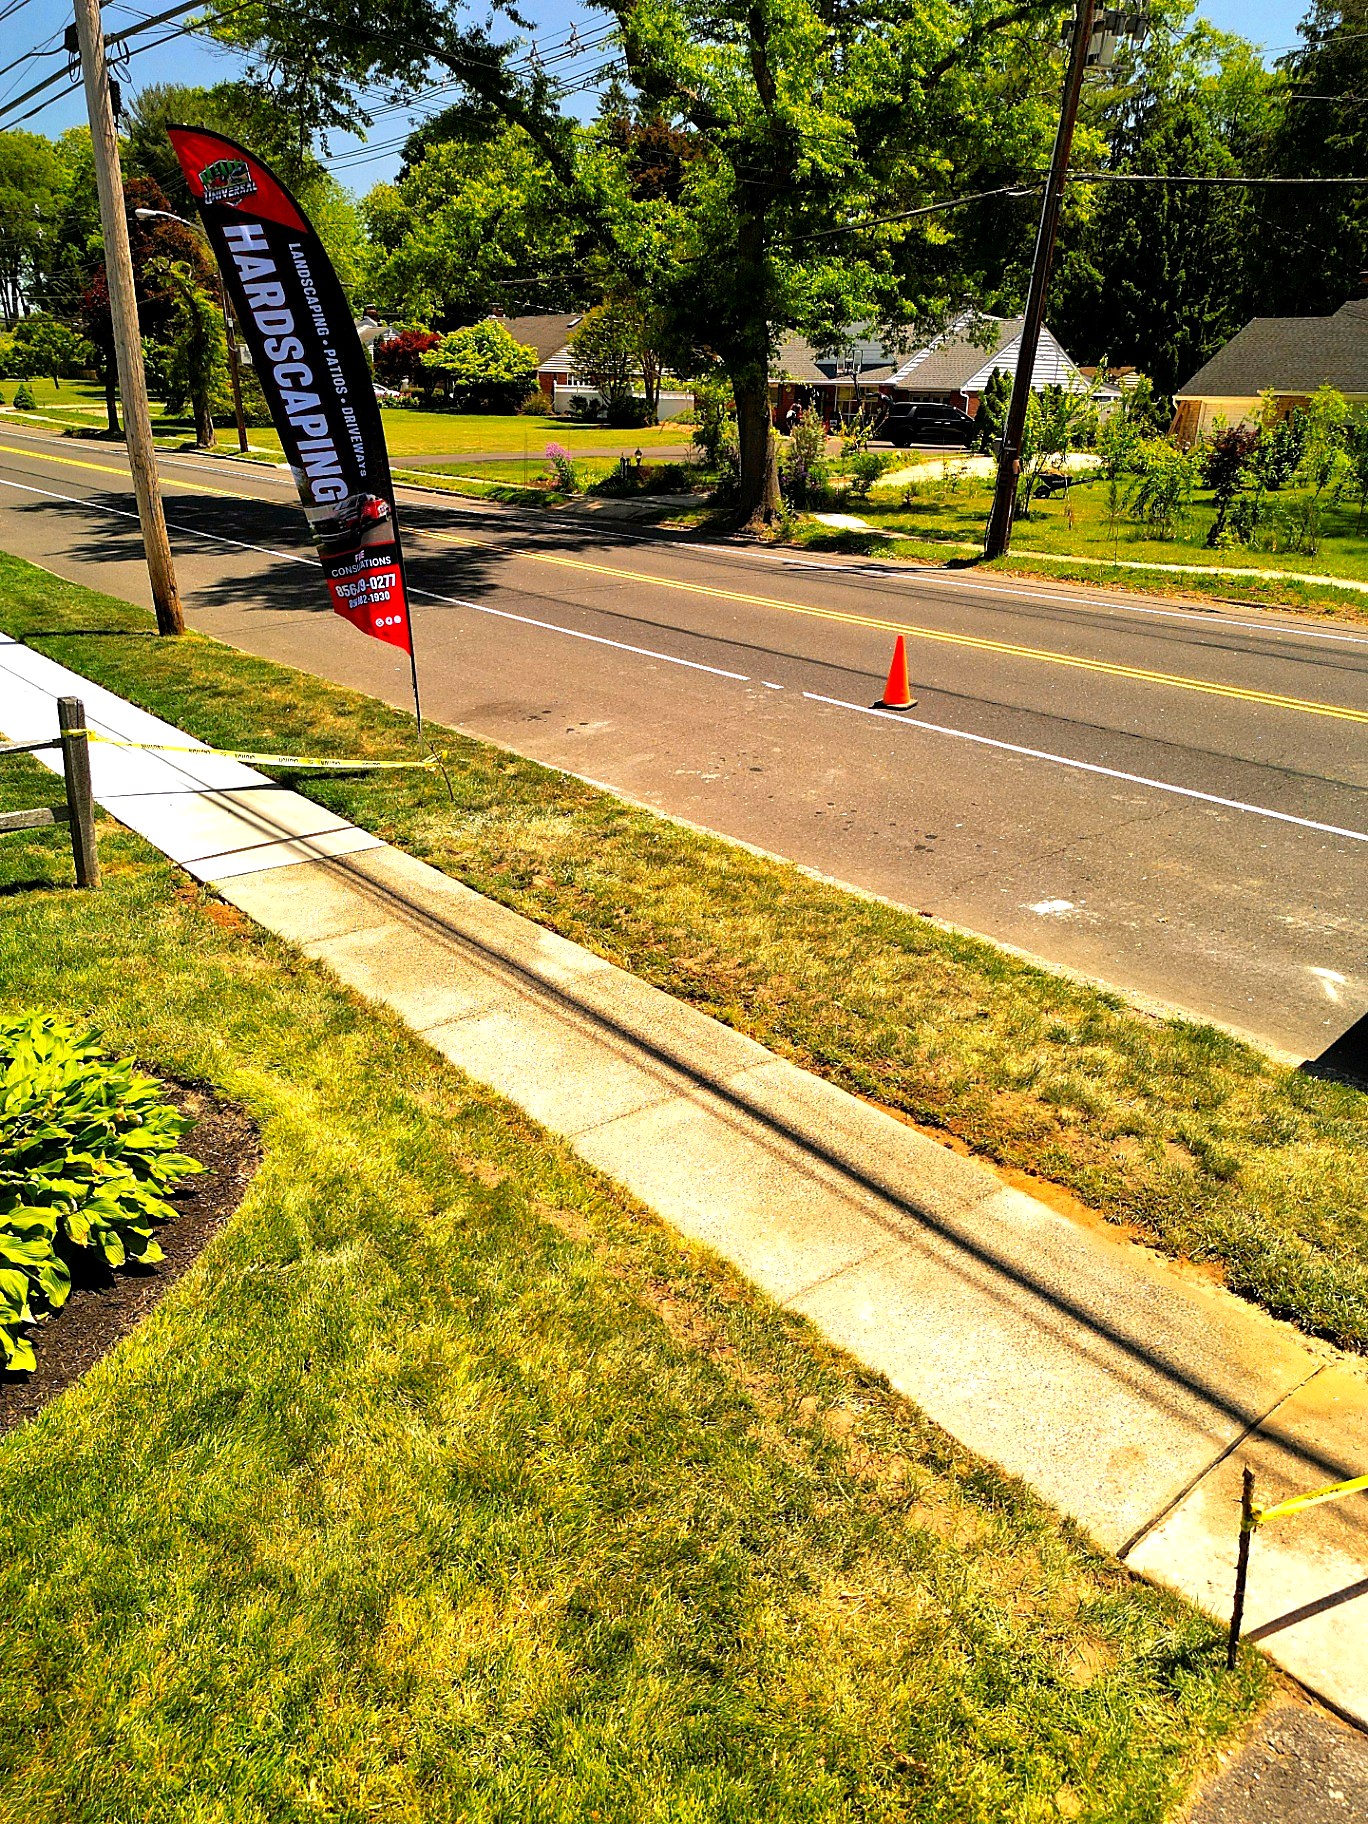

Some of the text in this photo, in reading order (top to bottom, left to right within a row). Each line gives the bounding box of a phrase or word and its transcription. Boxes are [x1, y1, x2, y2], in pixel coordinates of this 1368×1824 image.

[204, 182, 258, 204] UNIVERSAL
[222, 224, 349, 502] HARDSCAPING
[288, 243, 367, 477] LANDSCAPING PATIOS DRIVEWAYS
